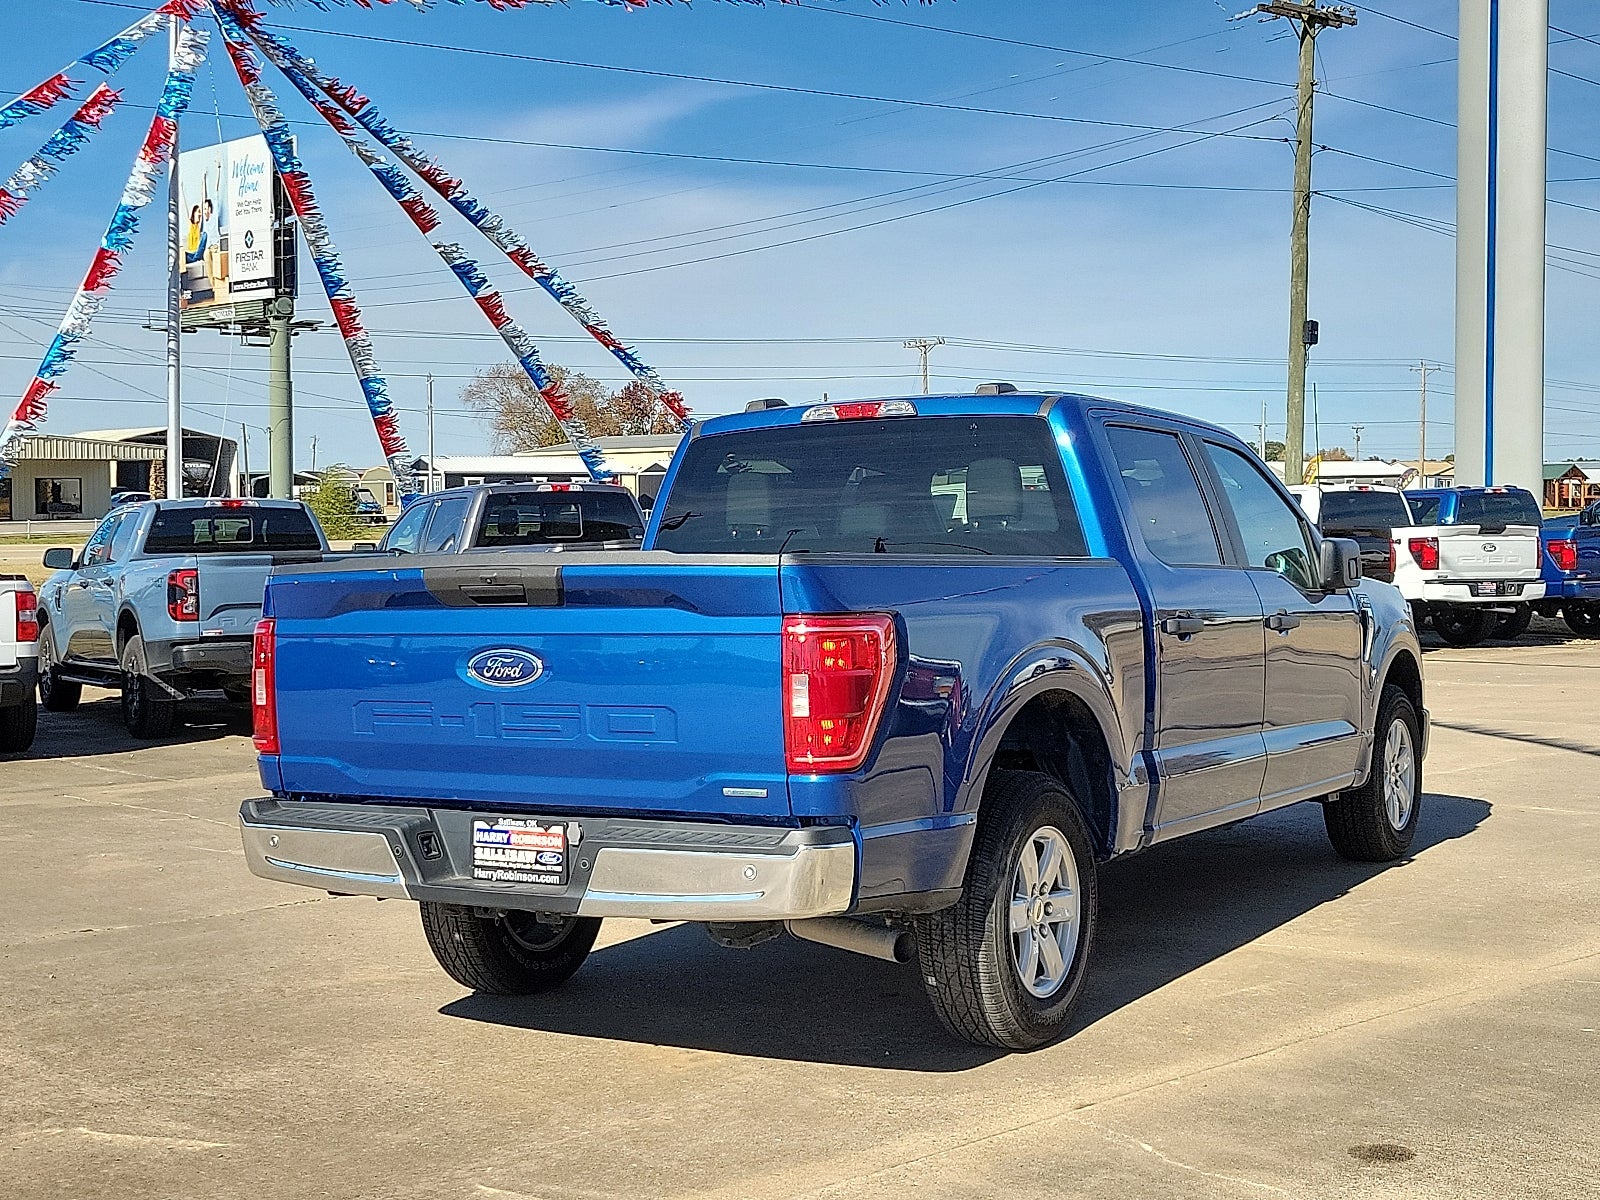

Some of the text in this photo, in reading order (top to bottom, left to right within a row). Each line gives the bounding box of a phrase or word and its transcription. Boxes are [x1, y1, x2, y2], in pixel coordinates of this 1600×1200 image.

[232, 154, 264, 179] Welcome
[238, 176, 259, 197] Home
[235, 250, 264, 263] FIRSTAR
[241, 262, 259, 273] BANK
[1458, 555, 1521, 564] F-150
[483, 656, 524, 678] Ford
[352, 701, 678, 744] F-150
[476, 831, 562, 847] HARRY ROBINSON
[474, 847, 537, 863] SALLISAW
[474, 868, 560, 884] HarryRobinson.com
